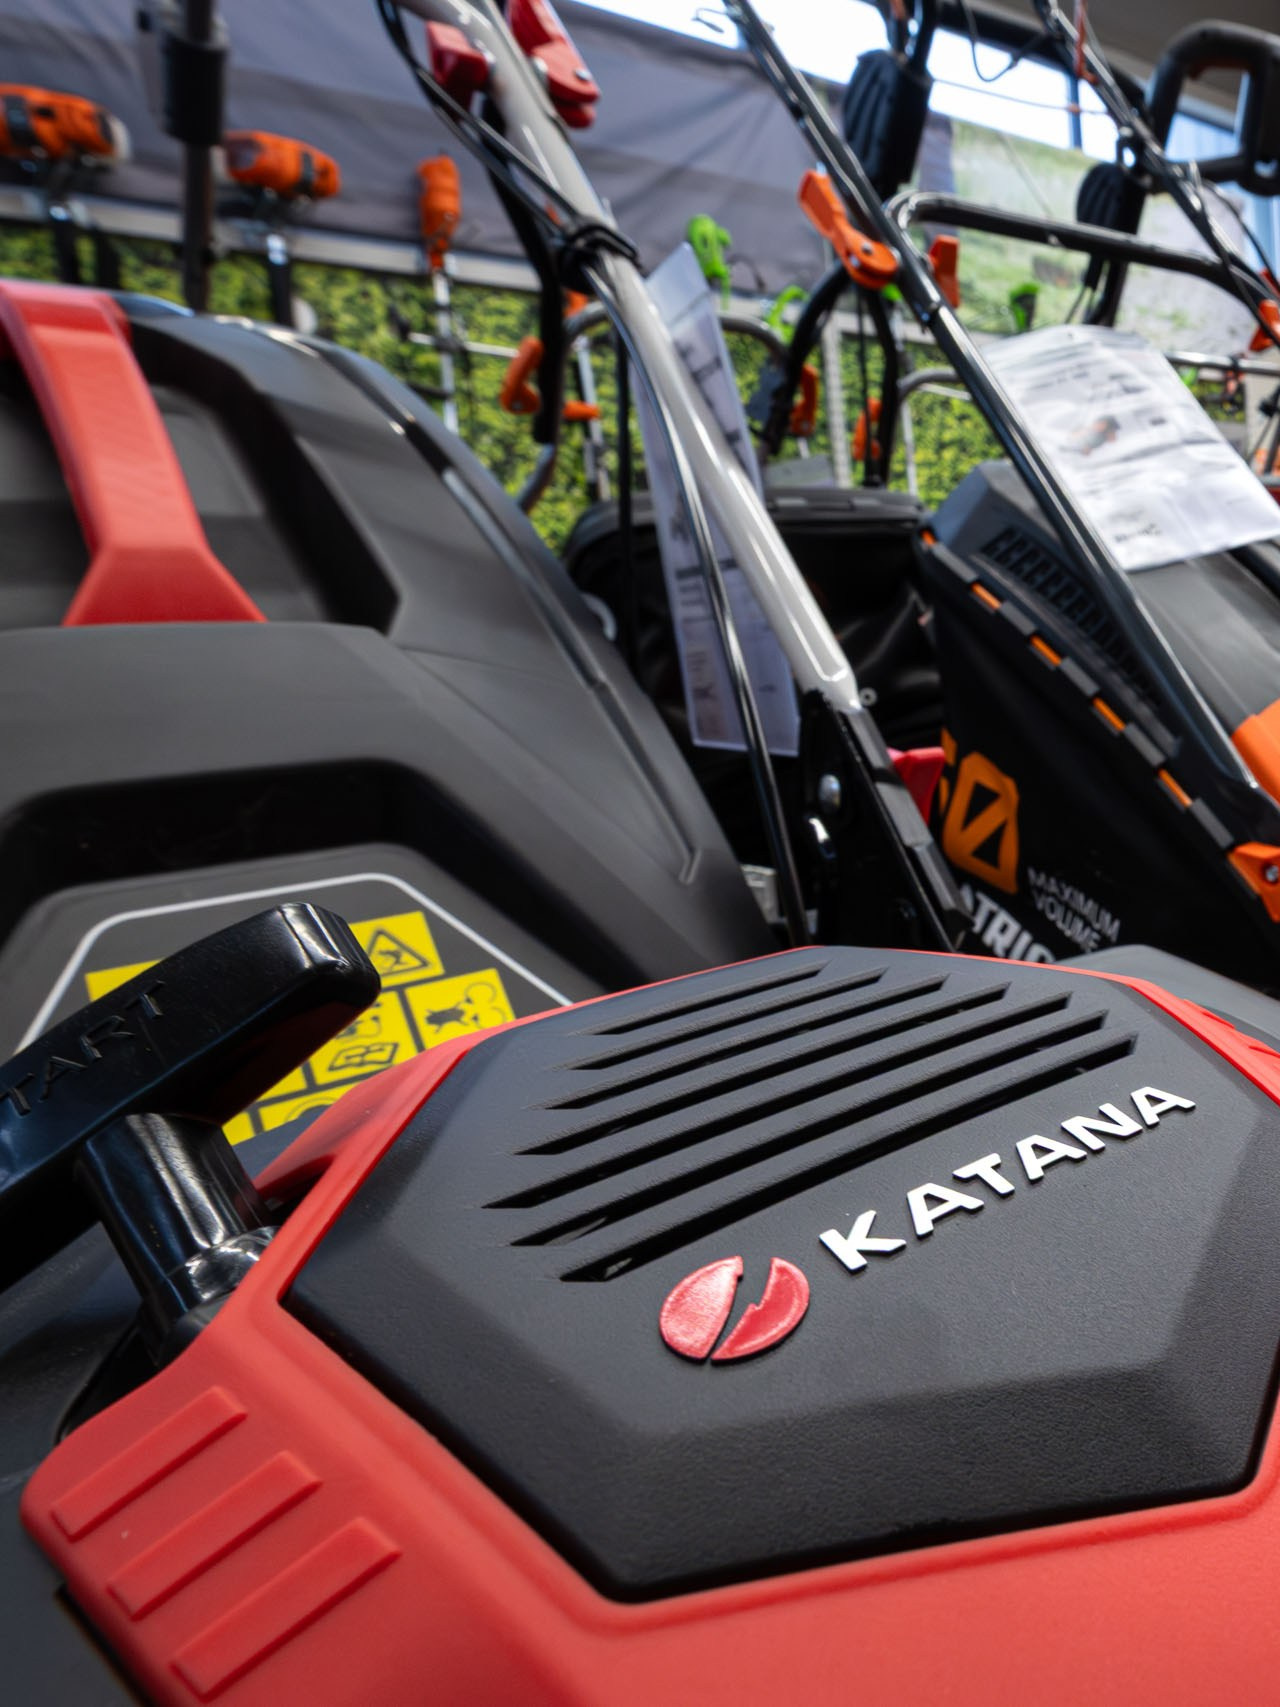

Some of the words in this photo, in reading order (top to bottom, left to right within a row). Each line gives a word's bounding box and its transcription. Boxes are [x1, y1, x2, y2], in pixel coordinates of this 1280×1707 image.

[1027, 866, 1121, 942] MAXIMUM
[1031, 888, 1101, 954] VOLUME
[819, 1086, 1196, 1271] KATANA
